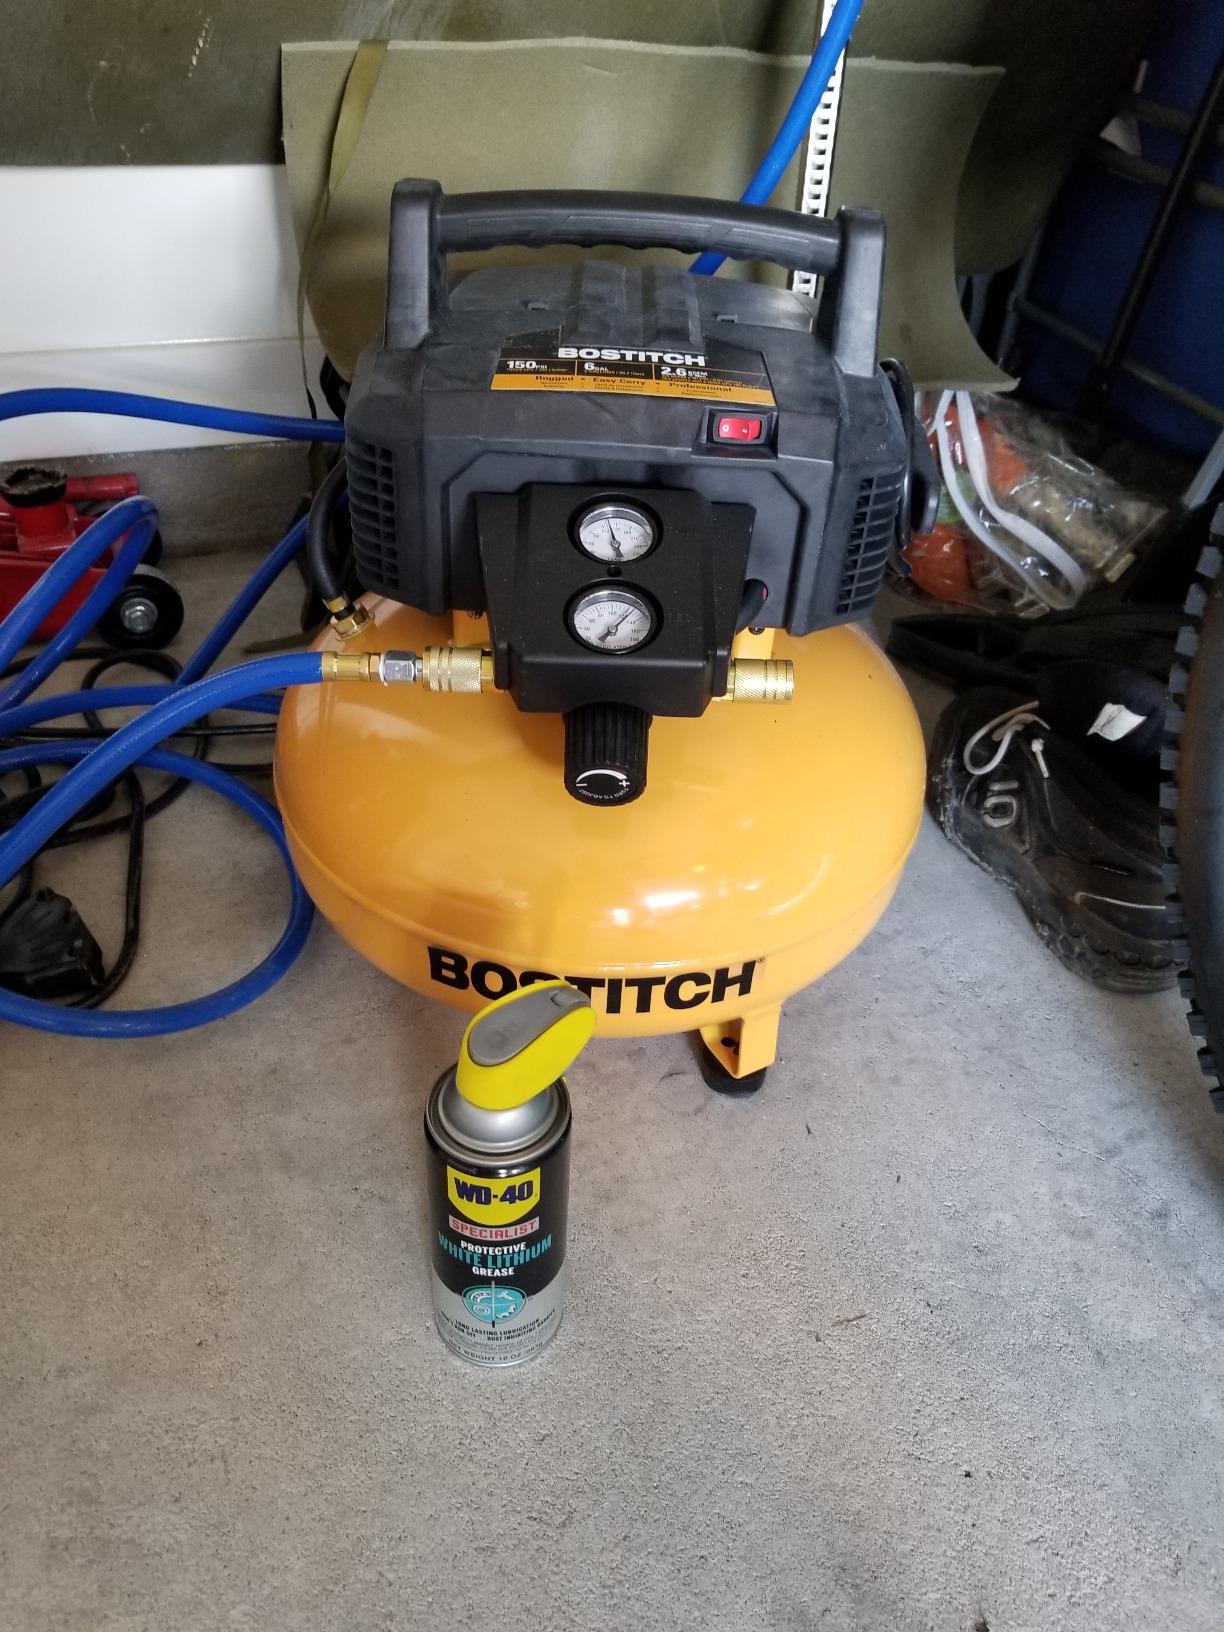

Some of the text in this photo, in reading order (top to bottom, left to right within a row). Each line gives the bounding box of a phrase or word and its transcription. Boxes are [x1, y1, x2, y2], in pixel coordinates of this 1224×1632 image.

[557, 347, 706, 367] BOSTITCH
[660, 366, 686, 377] 2.6
[619, 378, 646, 387] Carry
[668, 381, 732, 392] Professional
[453, 1177, 534, 1206] WD-40
[451, 1218, 537, 1240] SPECIALIST
[438, 1231, 553, 1269] WHITE LITHIUM
[460, 1239, 527, 1256] PROTECTIVE
[472, 1266, 515, 1277] GREASE
[471, 1327, 498, 1336] LASTING
